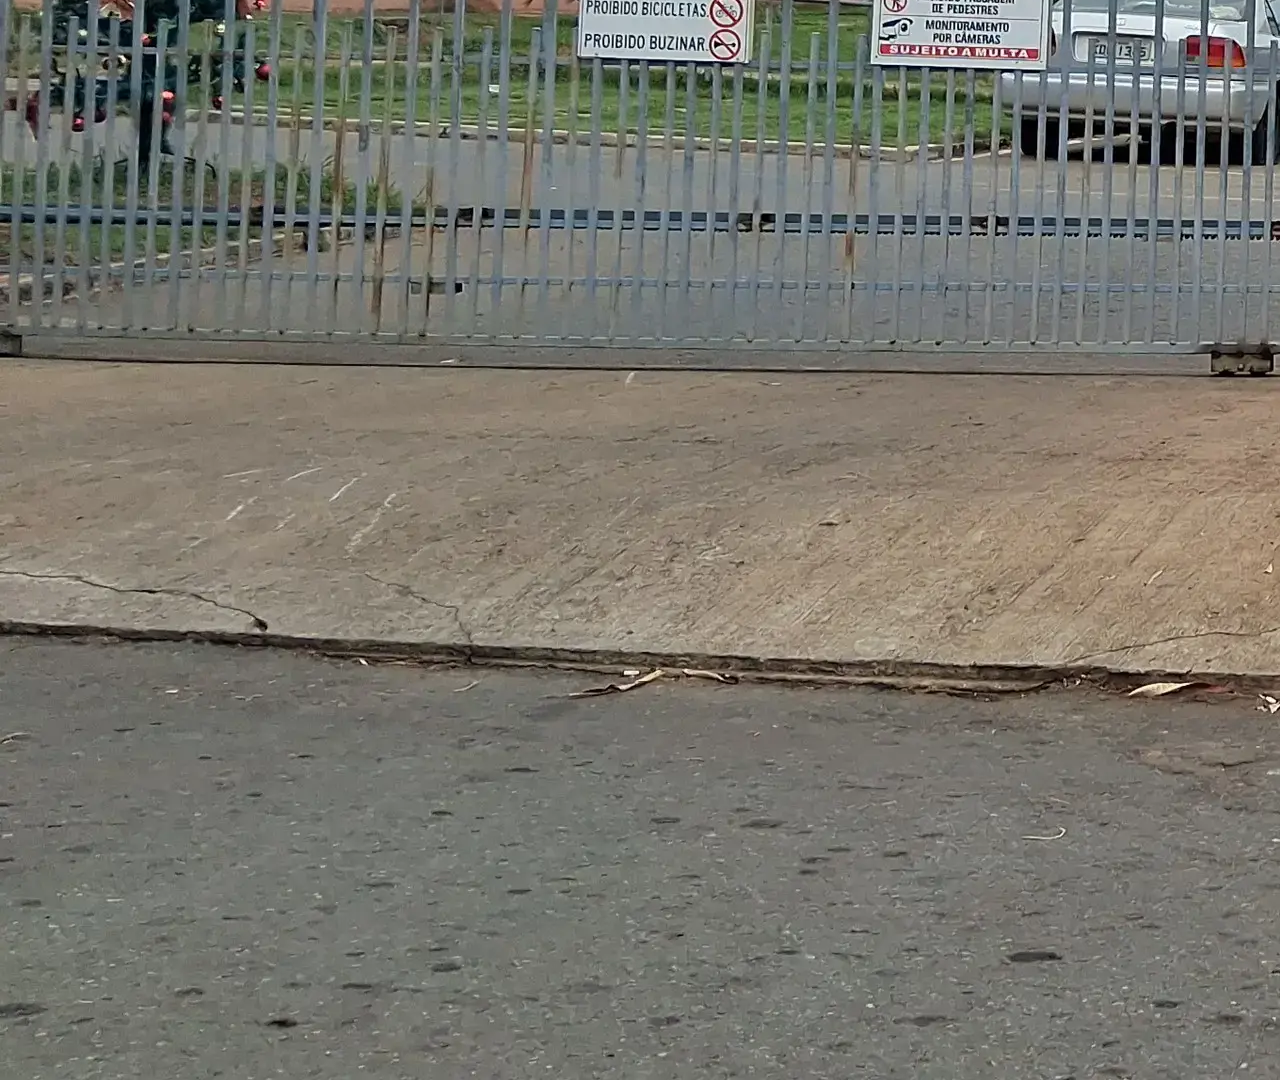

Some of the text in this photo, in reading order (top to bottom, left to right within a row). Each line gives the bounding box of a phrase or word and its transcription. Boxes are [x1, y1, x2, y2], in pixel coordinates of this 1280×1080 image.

[586, 0, 709, 18] PROIBIDO BICICLETAS.
[931, 4, 999, 15] DE PEDESTRES
[925, 20, 1010, 33] MONITORAMENTO
[584, 33, 709, 51] PROIBIDO BUZINAR.
[932, 31, 1001, 45] POR CÂMERAS
[889, 44, 1029, 58] SUJEITO A MULTA
